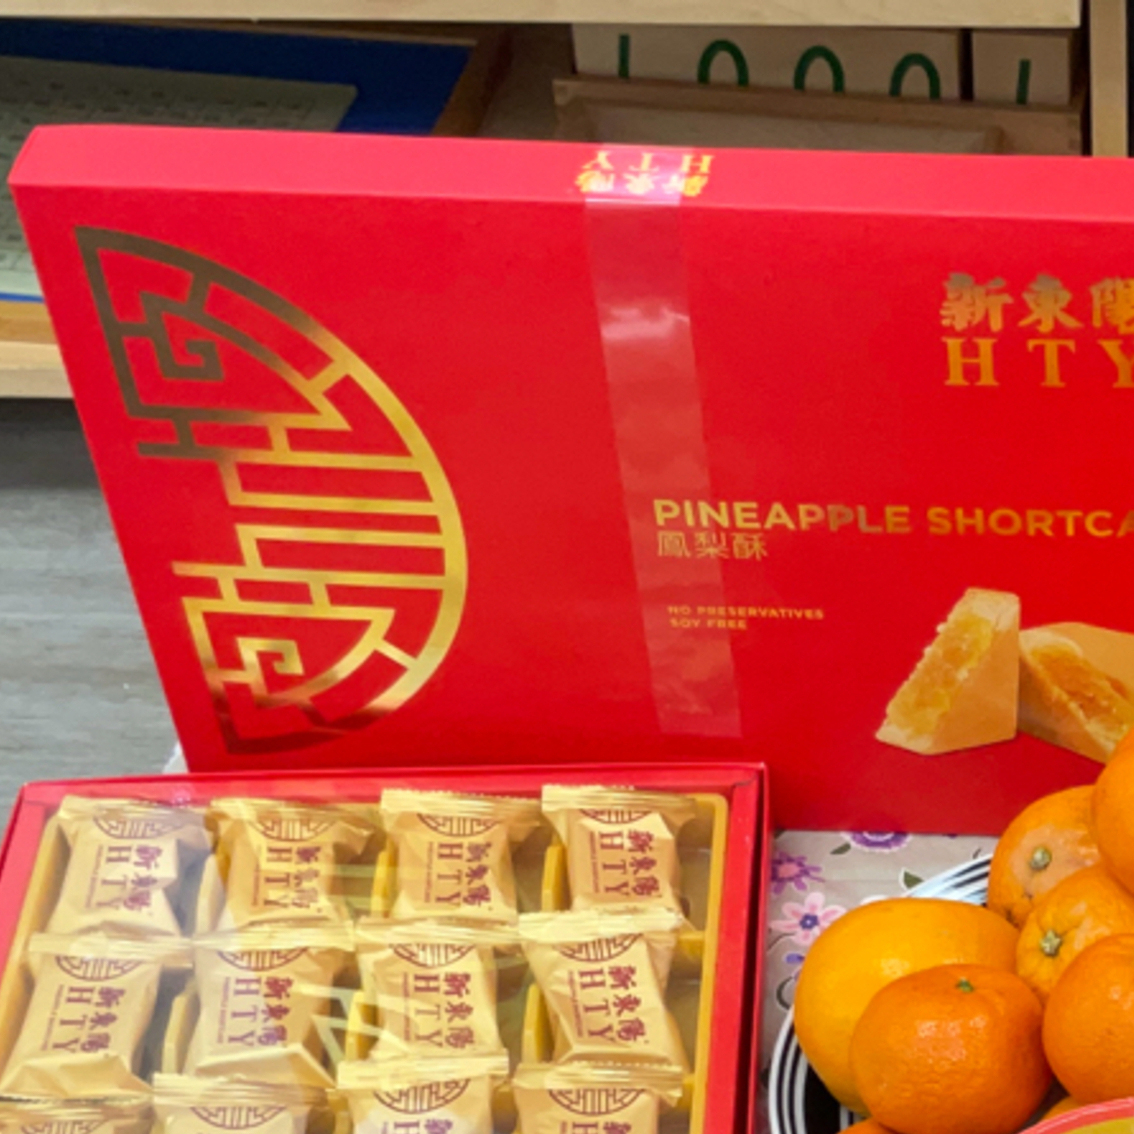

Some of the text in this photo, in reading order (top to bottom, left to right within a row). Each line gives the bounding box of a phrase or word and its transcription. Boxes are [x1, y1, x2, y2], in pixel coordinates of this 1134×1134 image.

[653, 499, 912, 534] PINEAPPLE
[657, 531, 768, 560] 鳳梨酥
[667, 605, 824, 620] NO PRESERVATIVES
[669, 618, 747, 630] SOY FREE
[598, 832, 631, 897] HTY
[52, 986, 96, 1052] HTY
[228, 977, 261, 1046] HTY
[414, 973, 443, 1048] HTY
[578, 968, 617, 1043] HTY
